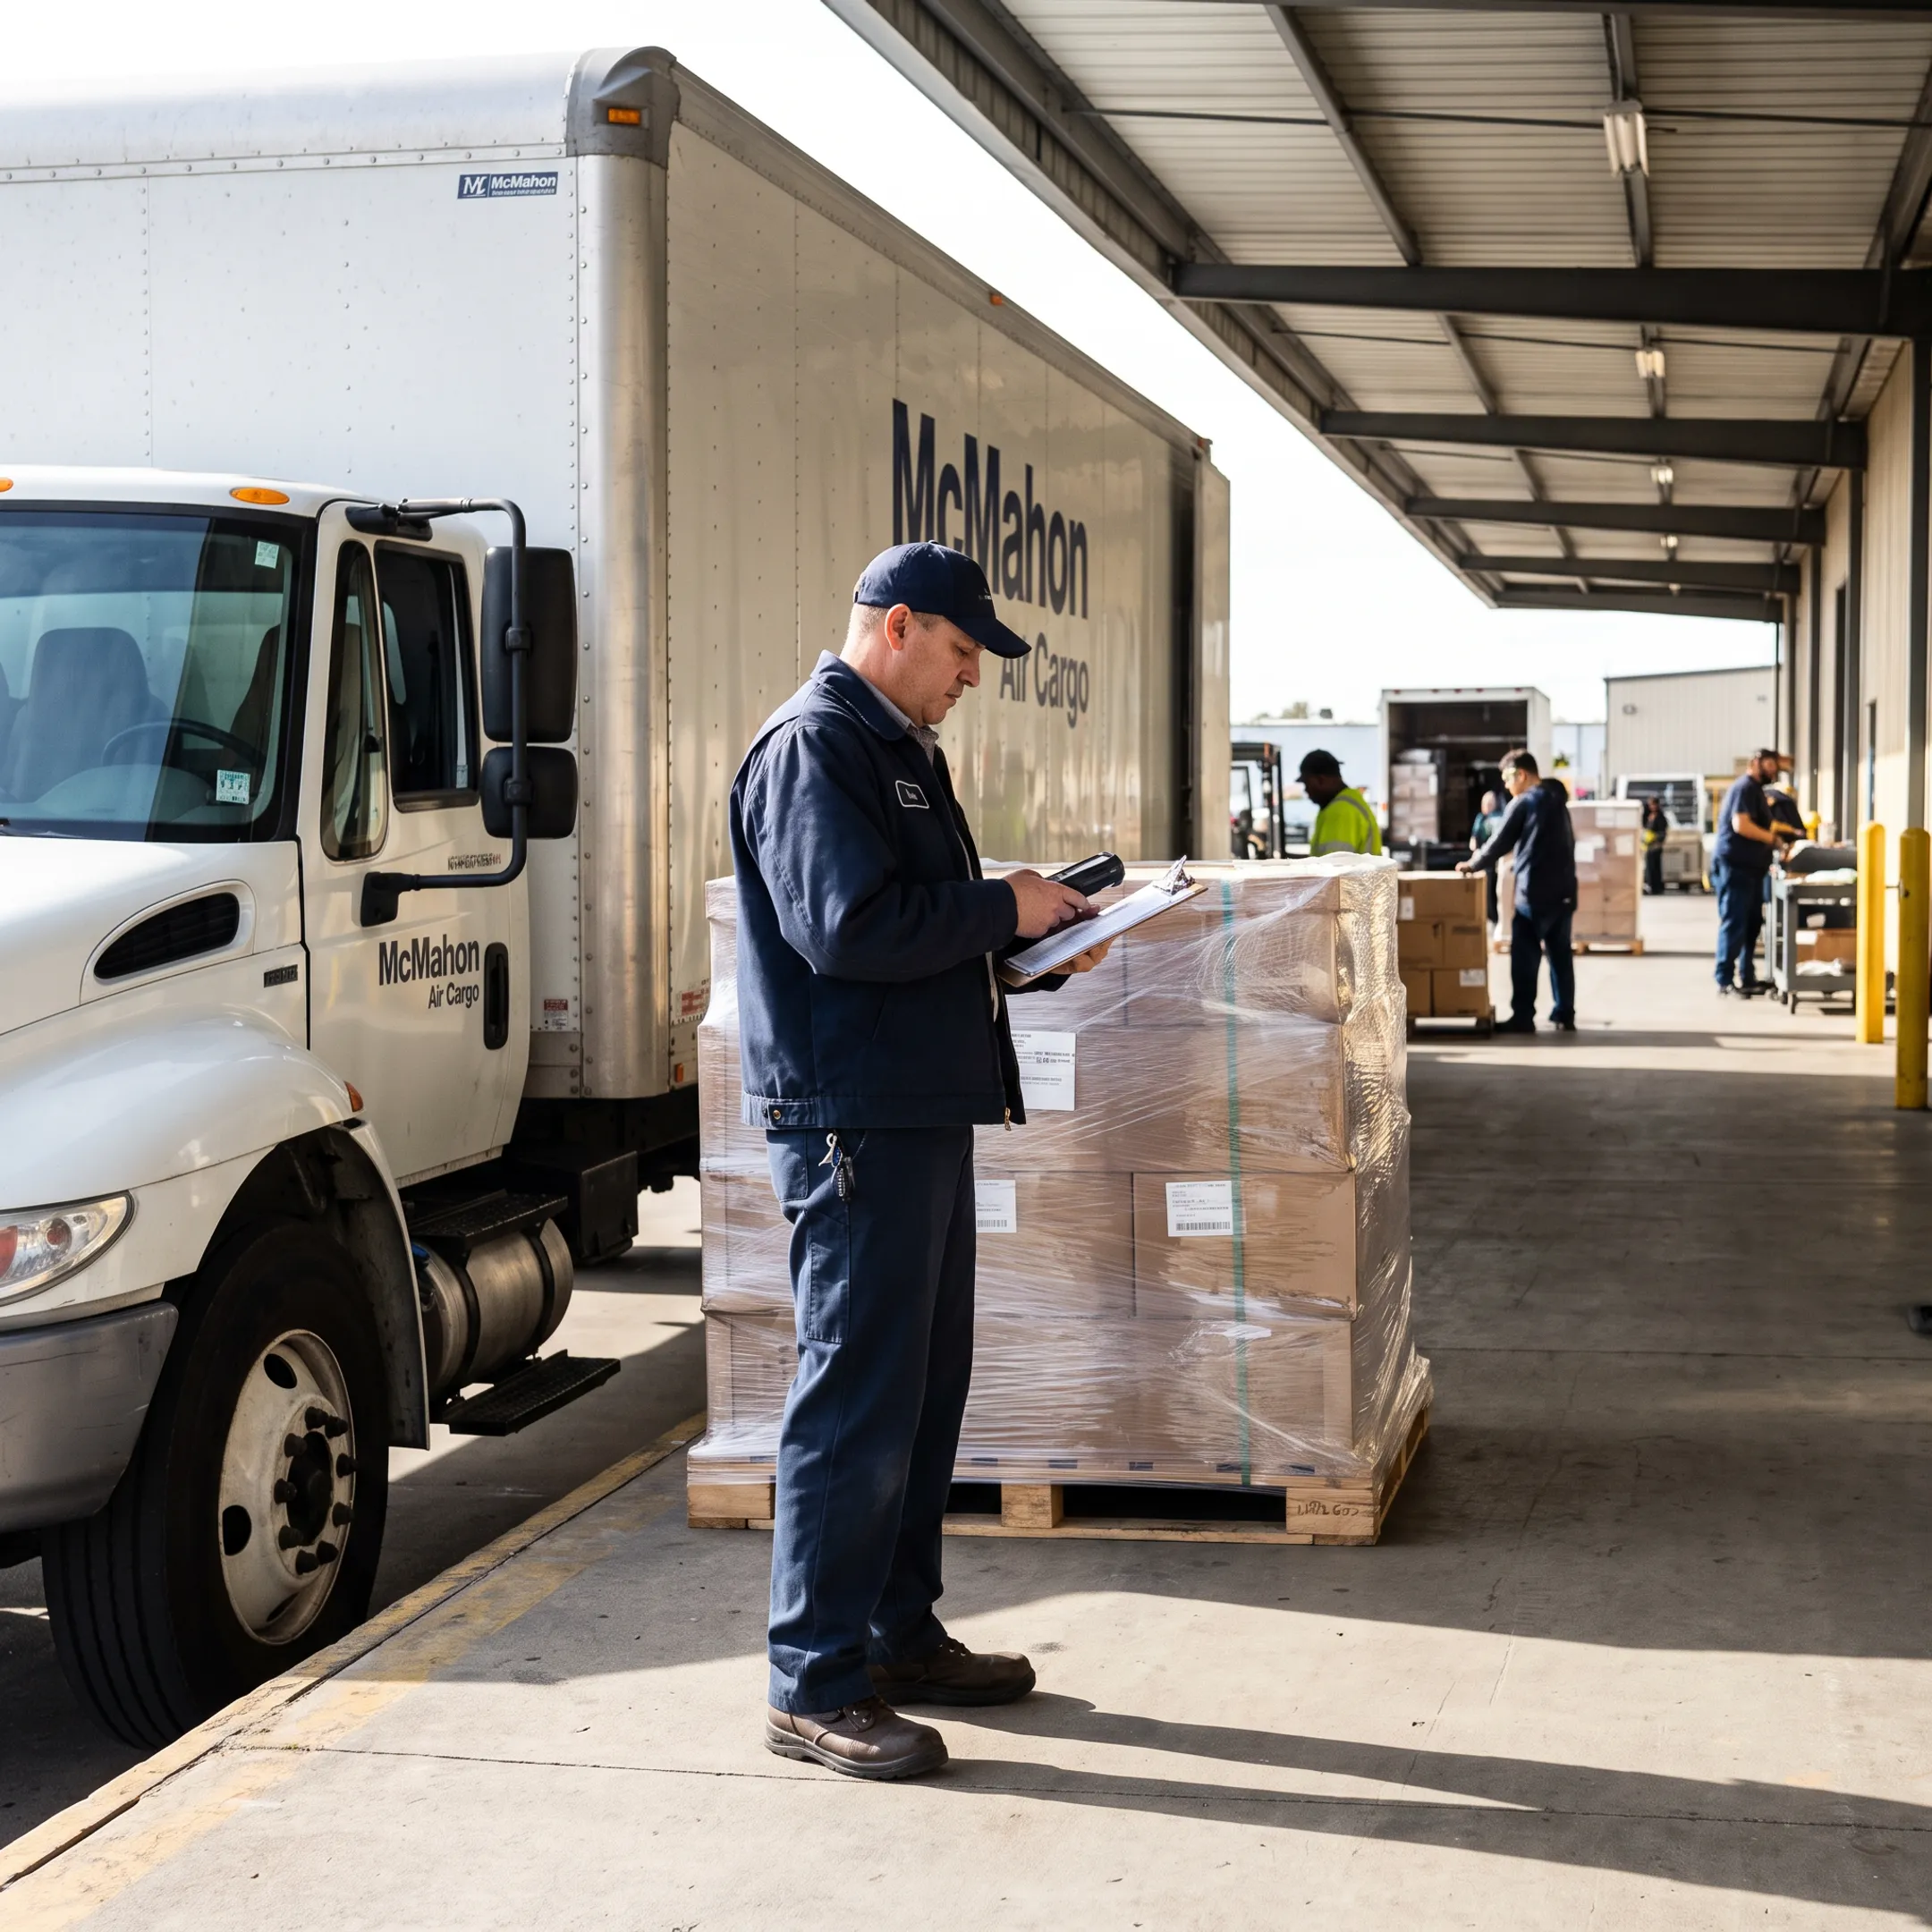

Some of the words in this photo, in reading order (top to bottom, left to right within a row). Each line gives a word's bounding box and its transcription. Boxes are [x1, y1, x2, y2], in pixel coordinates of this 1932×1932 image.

[491, 174, 556, 190] McMahon
[893, 398, 1088, 620] McMahon
[1034, 631, 1089, 729] Cargo
[379, 934, 479, 986] McMahon
[428, 985, 445, 1009] Air
[447, 982, 479, 1009] Cargo
